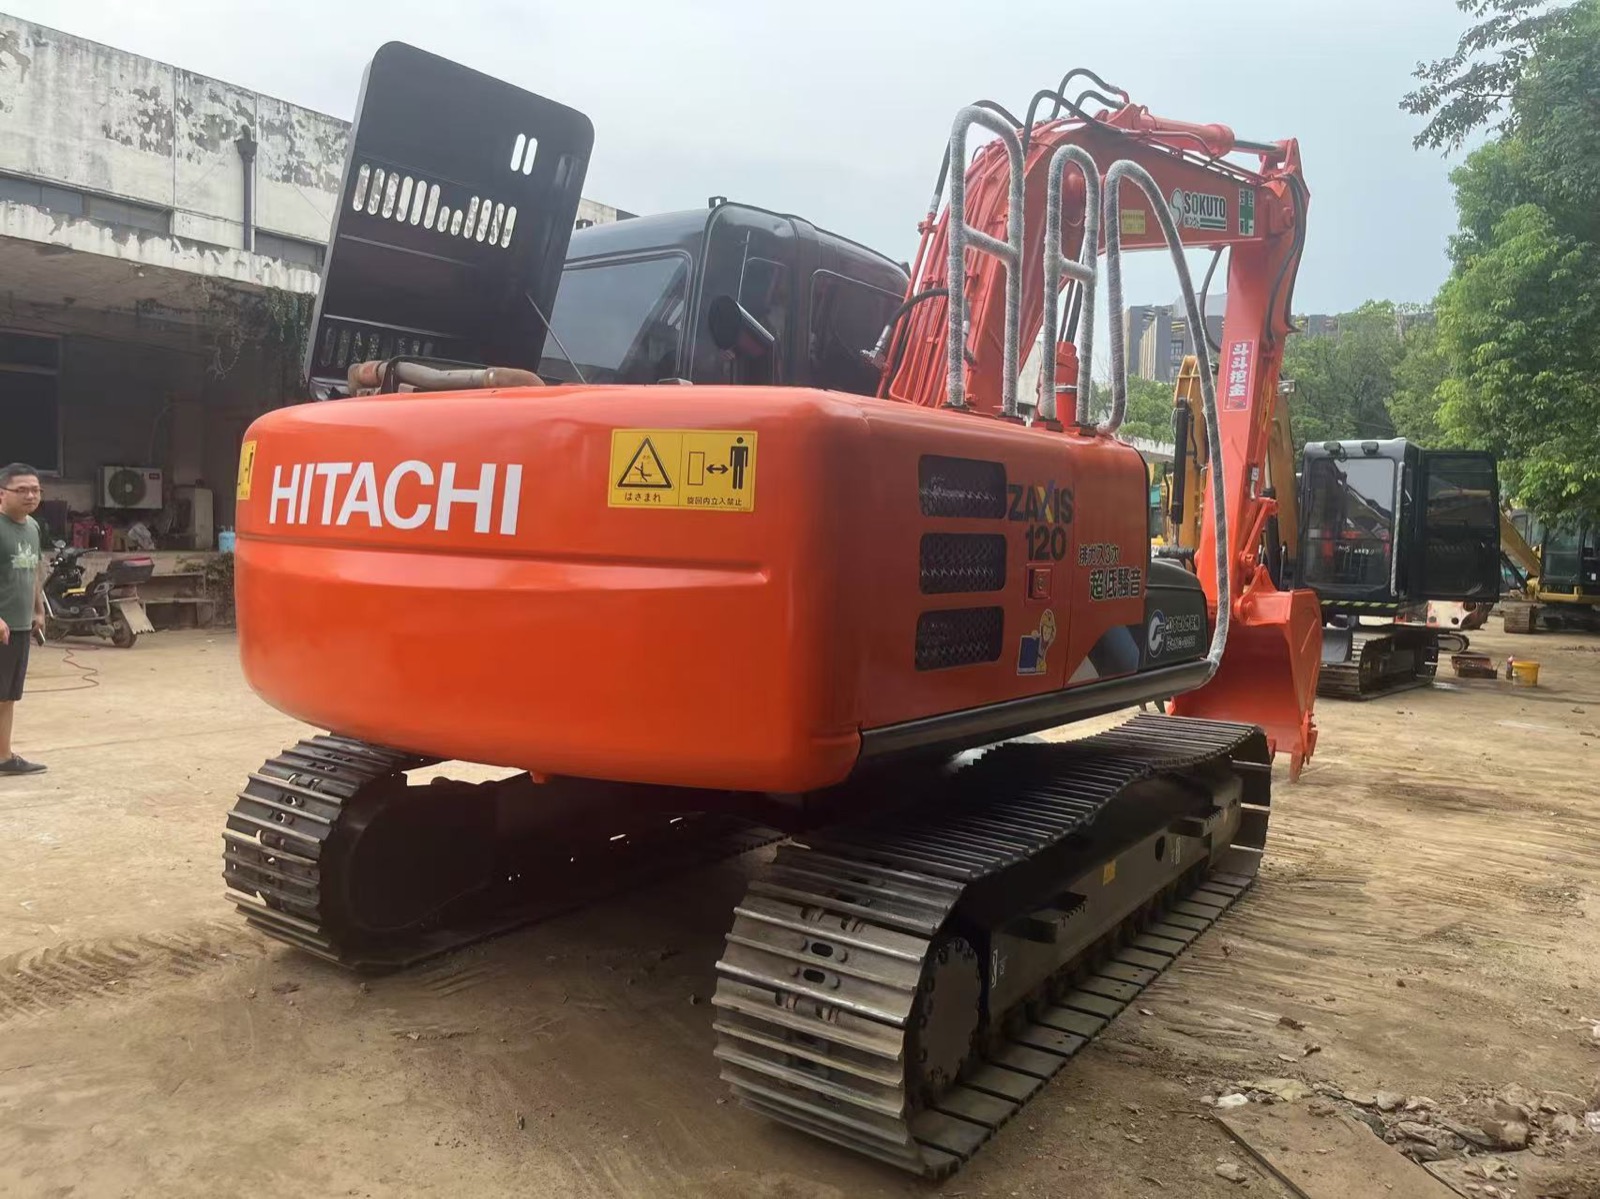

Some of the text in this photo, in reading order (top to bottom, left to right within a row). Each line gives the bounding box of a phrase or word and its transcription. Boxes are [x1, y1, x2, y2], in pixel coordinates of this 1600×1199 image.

[1184, 192, 1226, 218] SOKUTO
[268, 459, 523, 536] HITACHI
[624, 491, 662, 502] はさまれ
[686, 496, 743, 506] 旋回内立入禁止
[1007, 480, 1075, 525] ZAXIS
[1025, 525, 1067, 561] 120
